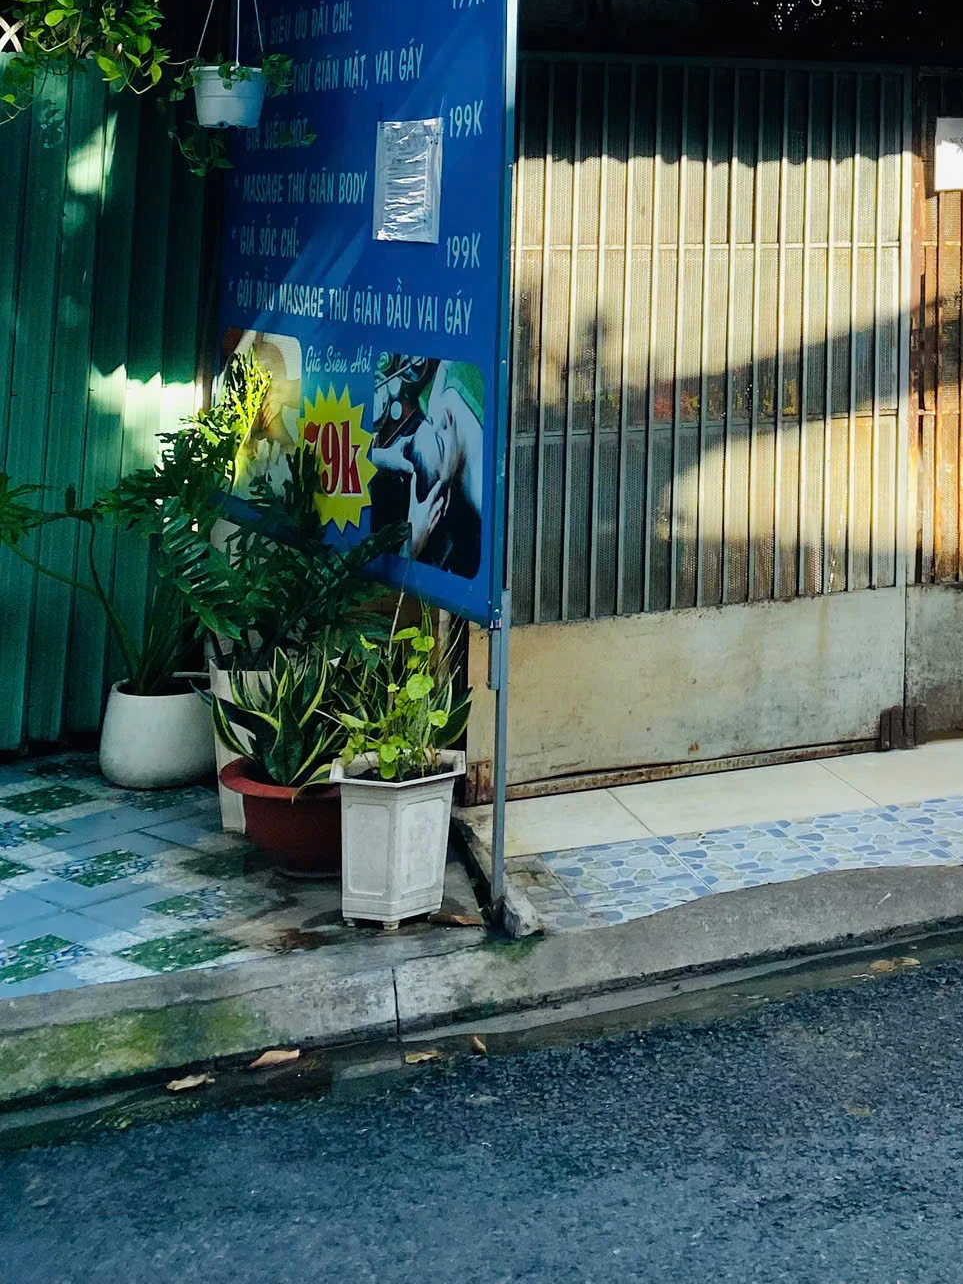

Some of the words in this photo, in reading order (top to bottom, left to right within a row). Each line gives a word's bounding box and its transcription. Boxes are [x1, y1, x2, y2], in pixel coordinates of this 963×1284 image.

[314, 54, 339, 92] GIÃN
[343, 49, 369, 96] MẶT,
[375, 50, 394, 85] VAI
[399, 37, 424, 82] GÁY
[449, 100, 483, 138] 199K
[242, 172, 283, 204] MASSAGE
[287, 166, 307, 204] THƯ
[309, 166, 334, 204] GIÃN
[338, 170, 367, 205] BODY
[239, 219, 256, 256] GIÁ
[446, 232, 481, 269] 199K
[279, 283, 324, 319] MASSAGE
[329, 283, 351, 322] THƯ
[353, 284, 381, 326] GIÃN
[386, 276, 411, 329] ĐẦU
[418, 296, 439, 332] VAI
[444, 289, 473, 336] GÁY
[305, 345, 322, 380] Giá
[324, 345, 348, 373] Siêu
